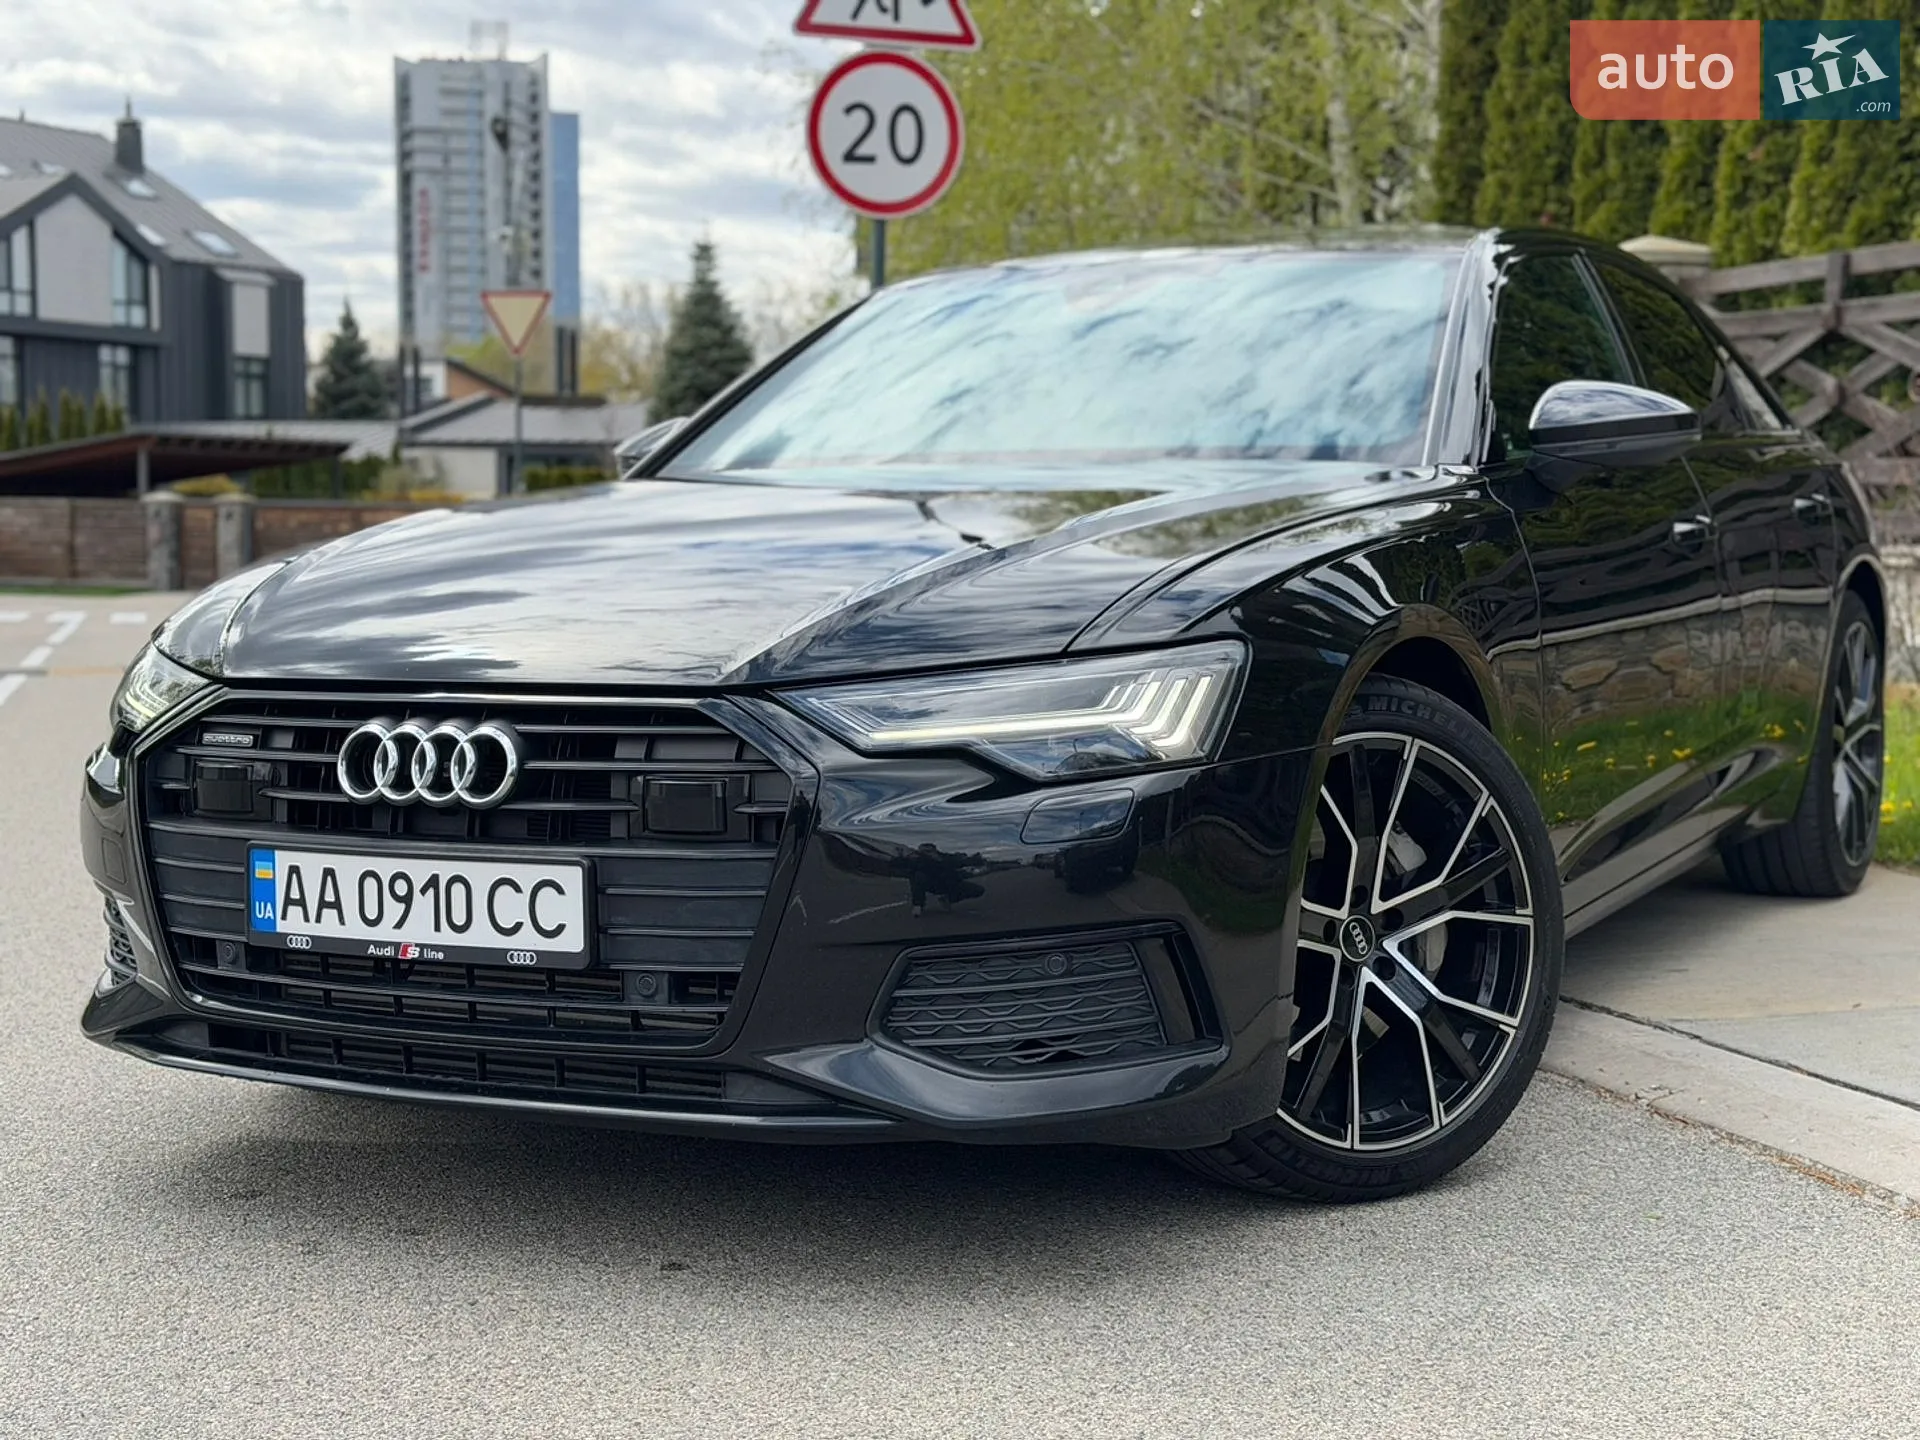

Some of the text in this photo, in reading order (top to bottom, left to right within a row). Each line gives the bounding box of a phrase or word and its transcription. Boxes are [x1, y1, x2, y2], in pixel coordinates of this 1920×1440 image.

[842, 102, 924, 165] 20
[1368, 696, 1482, 751] MICHELIN
[255, 900, 274, 920] UA
[280, 864, 567, 939] AA 0910 CC
[367, 944, 395, 957] Audi
[424, 948, 444, 960] line
